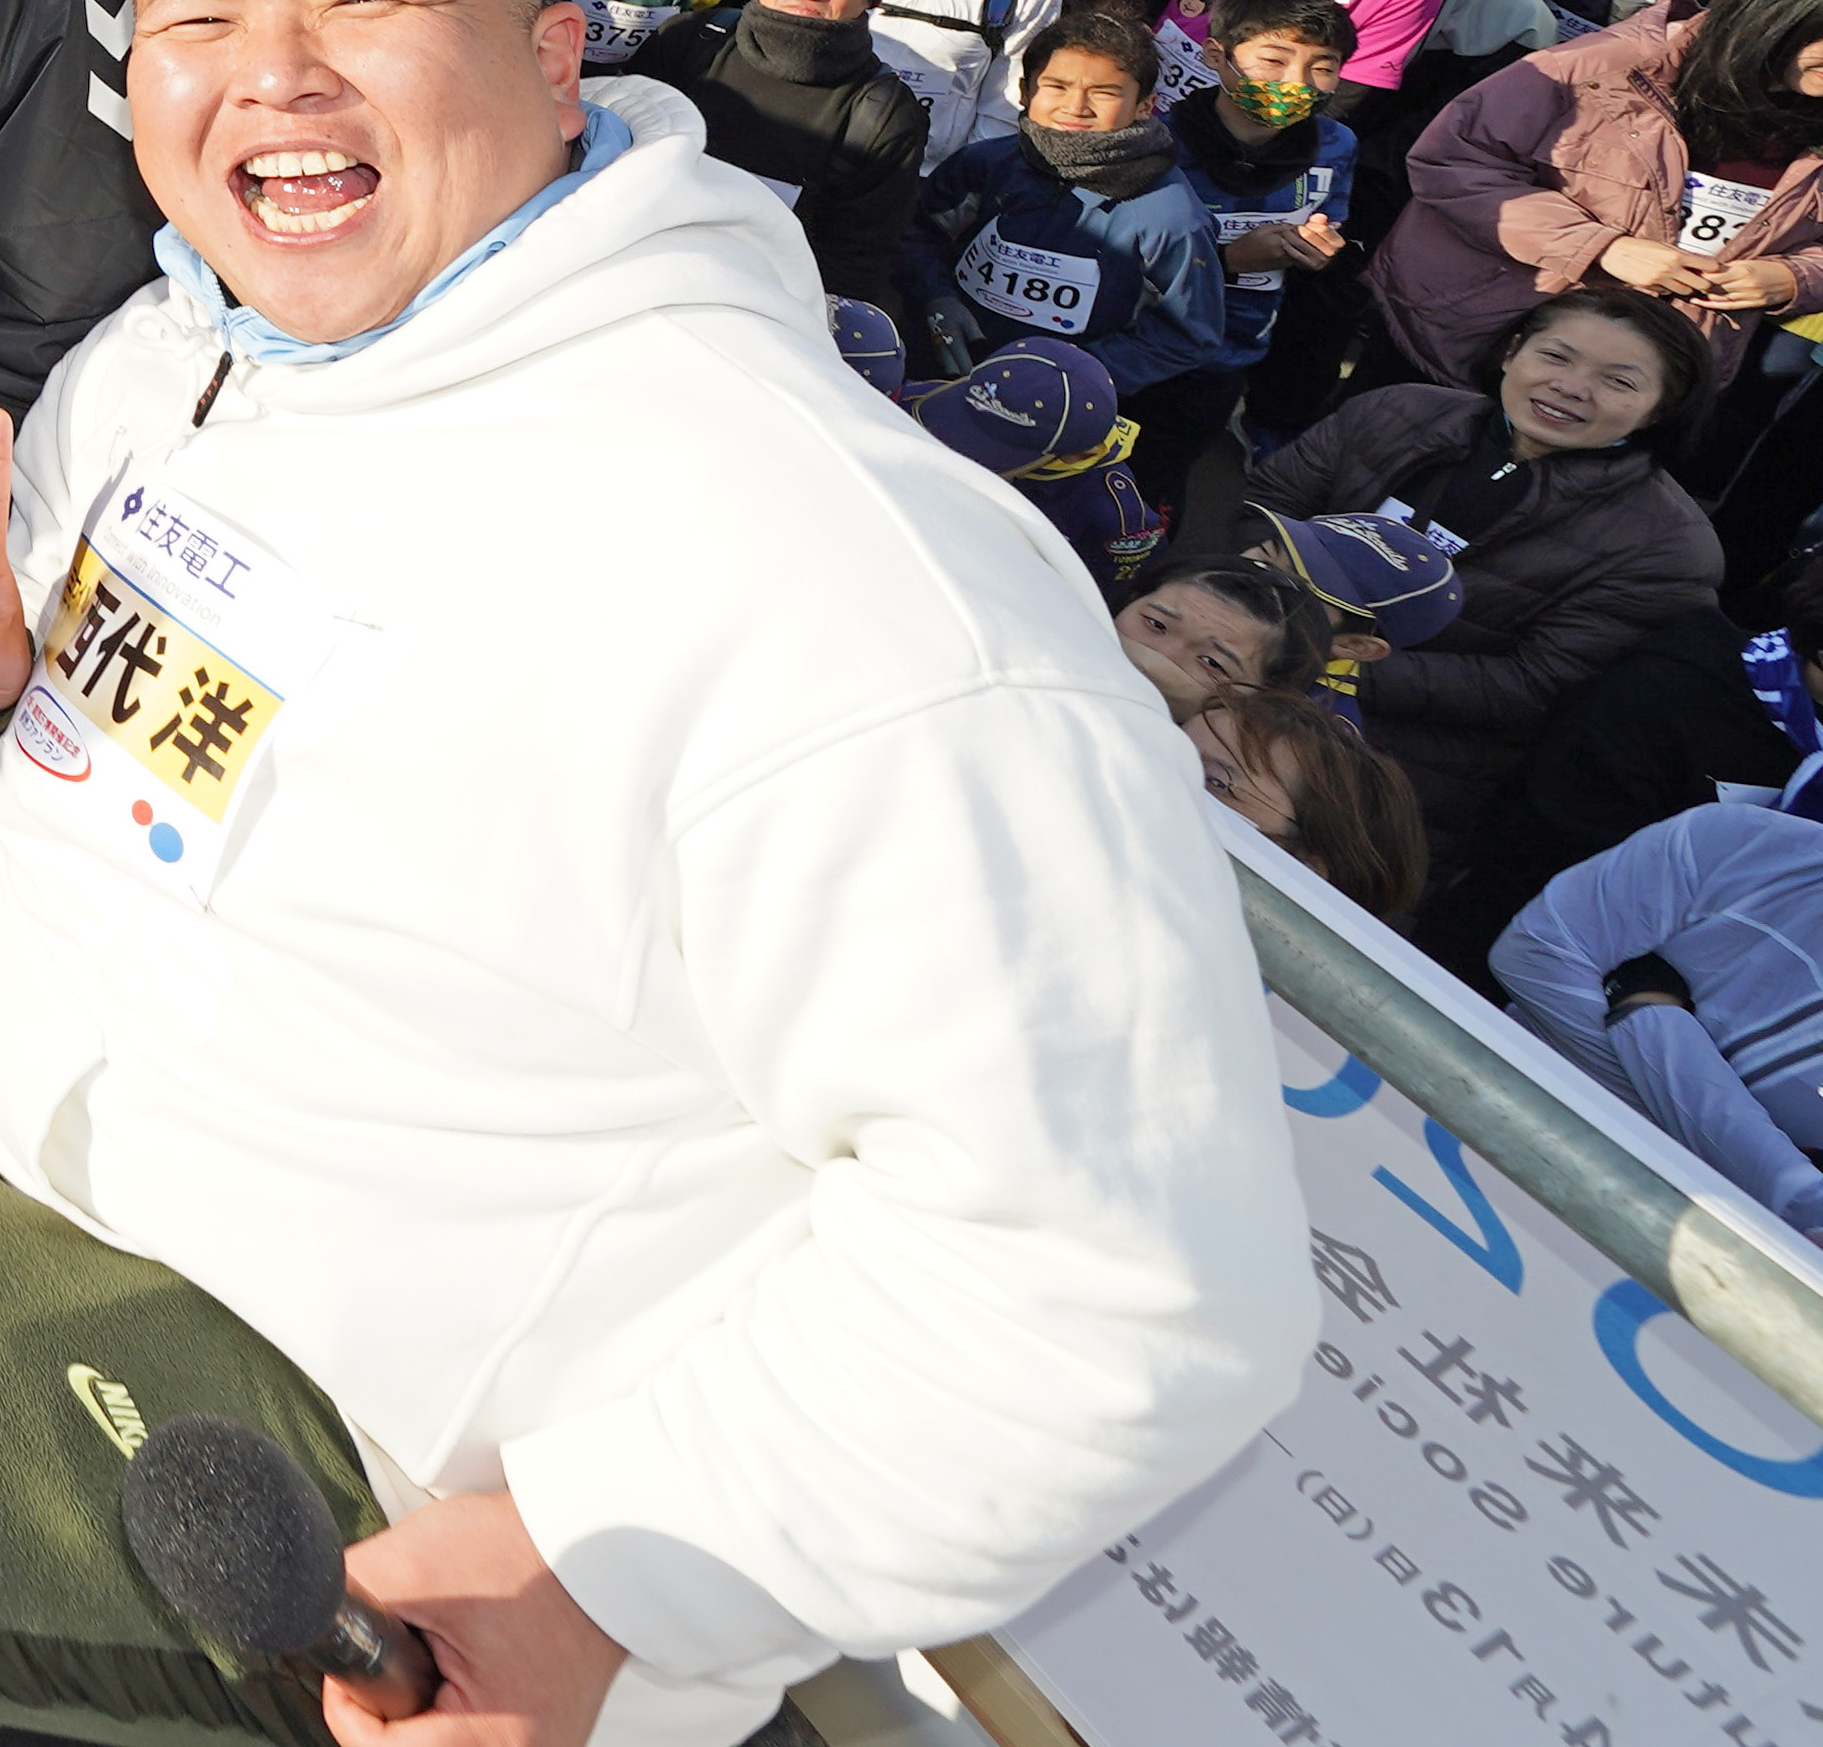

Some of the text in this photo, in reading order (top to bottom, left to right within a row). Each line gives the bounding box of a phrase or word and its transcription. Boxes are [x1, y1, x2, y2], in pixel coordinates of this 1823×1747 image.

[996, 242, 1063, 269] 住友電工
[977, 260, 1081, 310] 4180
[136, 499, 251, 600] 住友電工
[145, 563, 223, 628] Innovation
